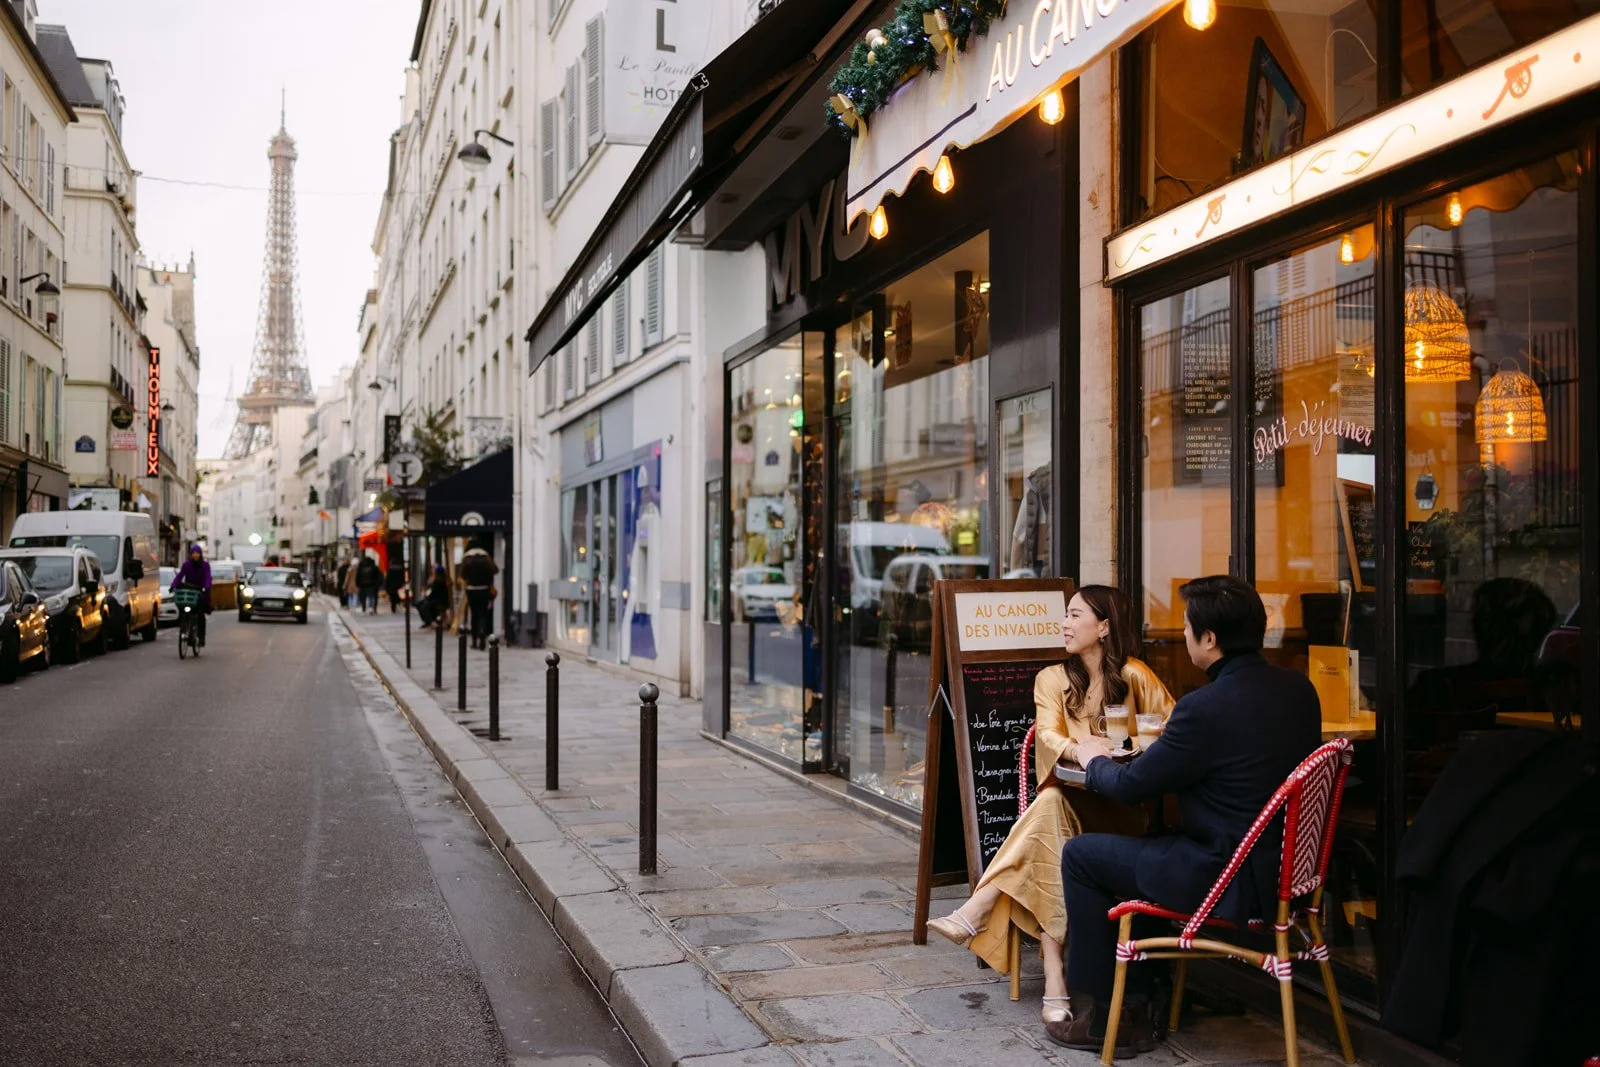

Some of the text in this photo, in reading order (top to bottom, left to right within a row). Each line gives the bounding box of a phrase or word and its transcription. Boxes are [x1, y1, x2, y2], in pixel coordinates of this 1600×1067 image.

[615, 55, 701, 77] Le Pavill
[986, 24, 1024, 102] AU
[147, 349, 160, 475] THOUMIEUX
[975, 603, 1048, 618] AU CANON
[965, 622, 1060, 638] DES INVALIDES
[988, 709, 1002, 728] Foie
[976, 734, 1000, 752] Verrine
[977, 786, 1015, 804] Brandade
[980, 810, 1014, 824] Tiramisu
